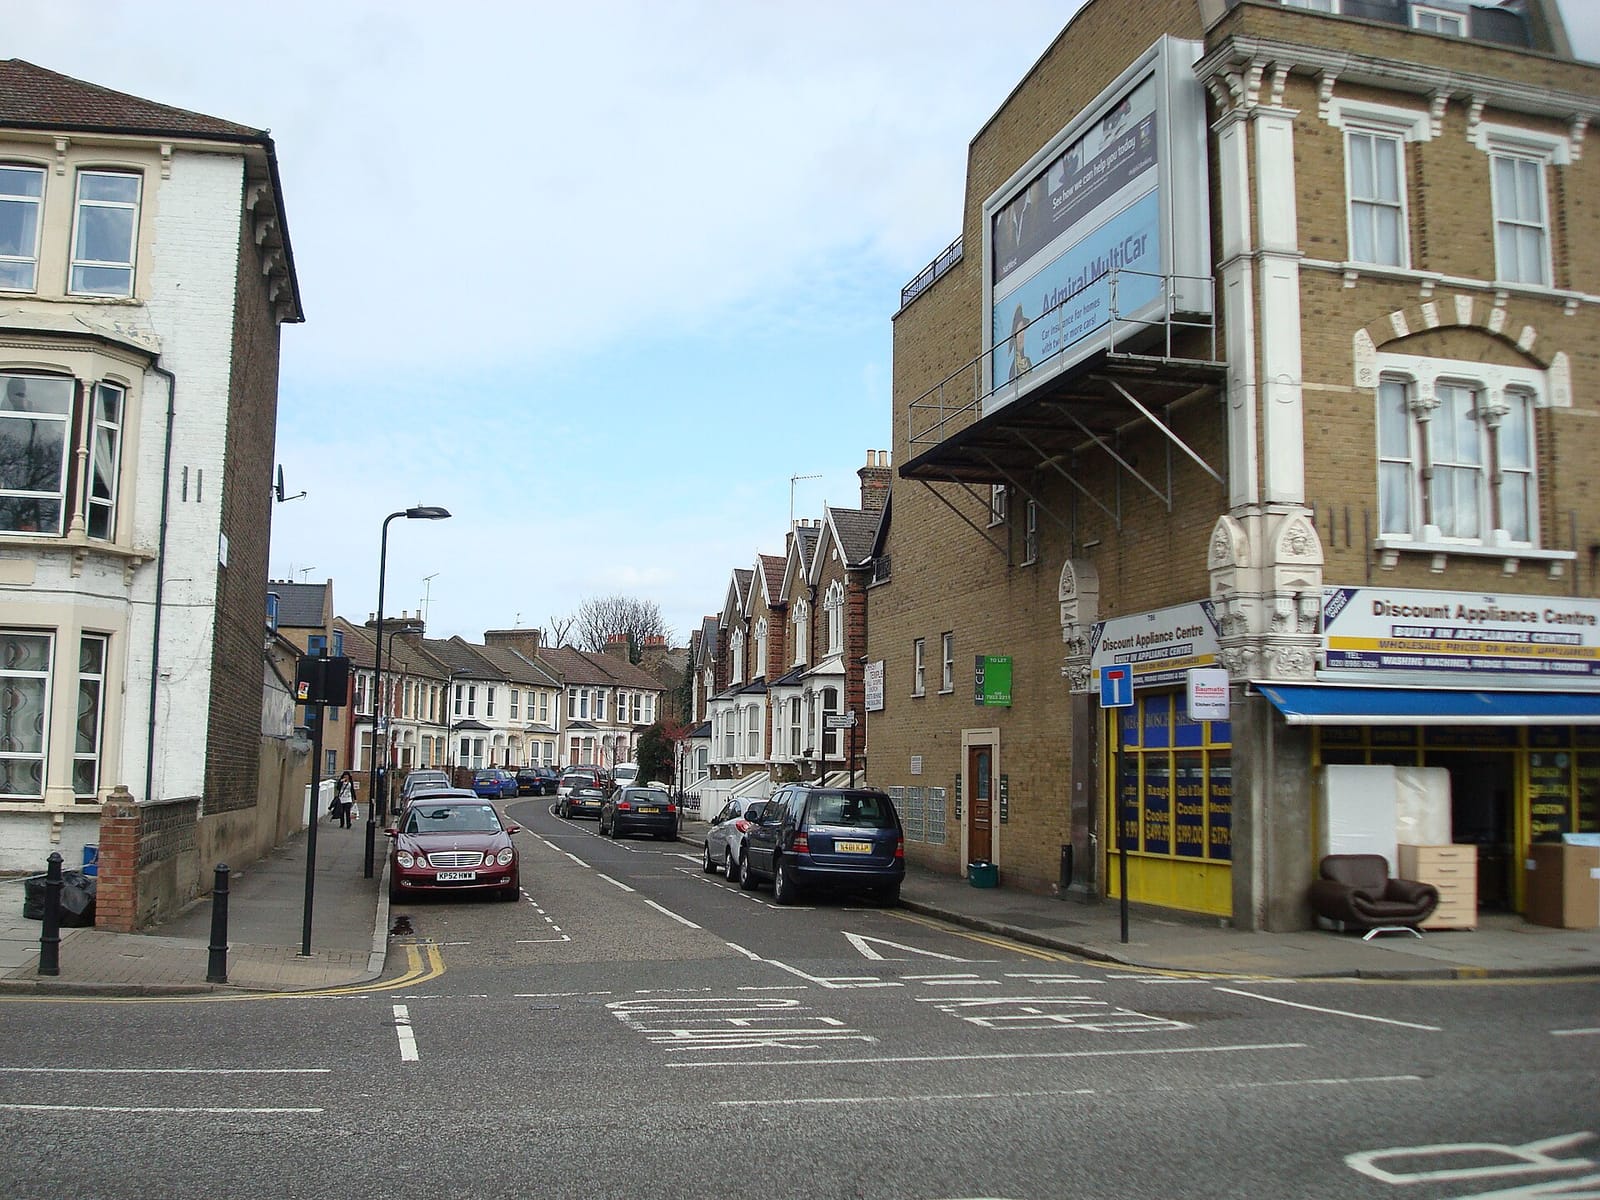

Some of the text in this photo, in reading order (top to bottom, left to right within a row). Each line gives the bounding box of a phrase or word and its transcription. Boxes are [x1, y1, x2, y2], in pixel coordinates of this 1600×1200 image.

[1052, 197, 1062, 210] See
[1062, 187, 1074, 200] how
[1074, 178, 1082, 190] we
[1082, 170, 1094, 185] can
[1094, 156, 1107, 176] help
[1107, 151, 1118, 169] you
[1118, 137, 1136, 157] today
[1042, 233, 1148, 319] Admiral MultiCar
[1041, 328, 1050, 341] Car
[1083, 297, 1101, 315] homes
[1041, 339, 1053, 355] with
[1069, 323, 1083, 340] more
[1372, 600, 1598, 626] Discount Appliance Centre
[1102, 635, 1134, 651] Discount
[1135, 631, 1174, 648] Appliance
[1175, 625, 1204, 640] Centre
[1378, 640, 1441, 651] WHOLESALE
[1393, 627, 1434, 638] BUILT
[1454, 629, 1530, 642] APPLIANCE
[1138, 648, 1169, 660] APPLIANCE
[1169, 644, 1192, 657] CENTRE
[1382, 656, 1424, 666] WASHING
[439, 872, 458, 880] KP52
[604, 998, 879, 1051] CLEAR
[914, 996, 1196, 1033] KEEP
